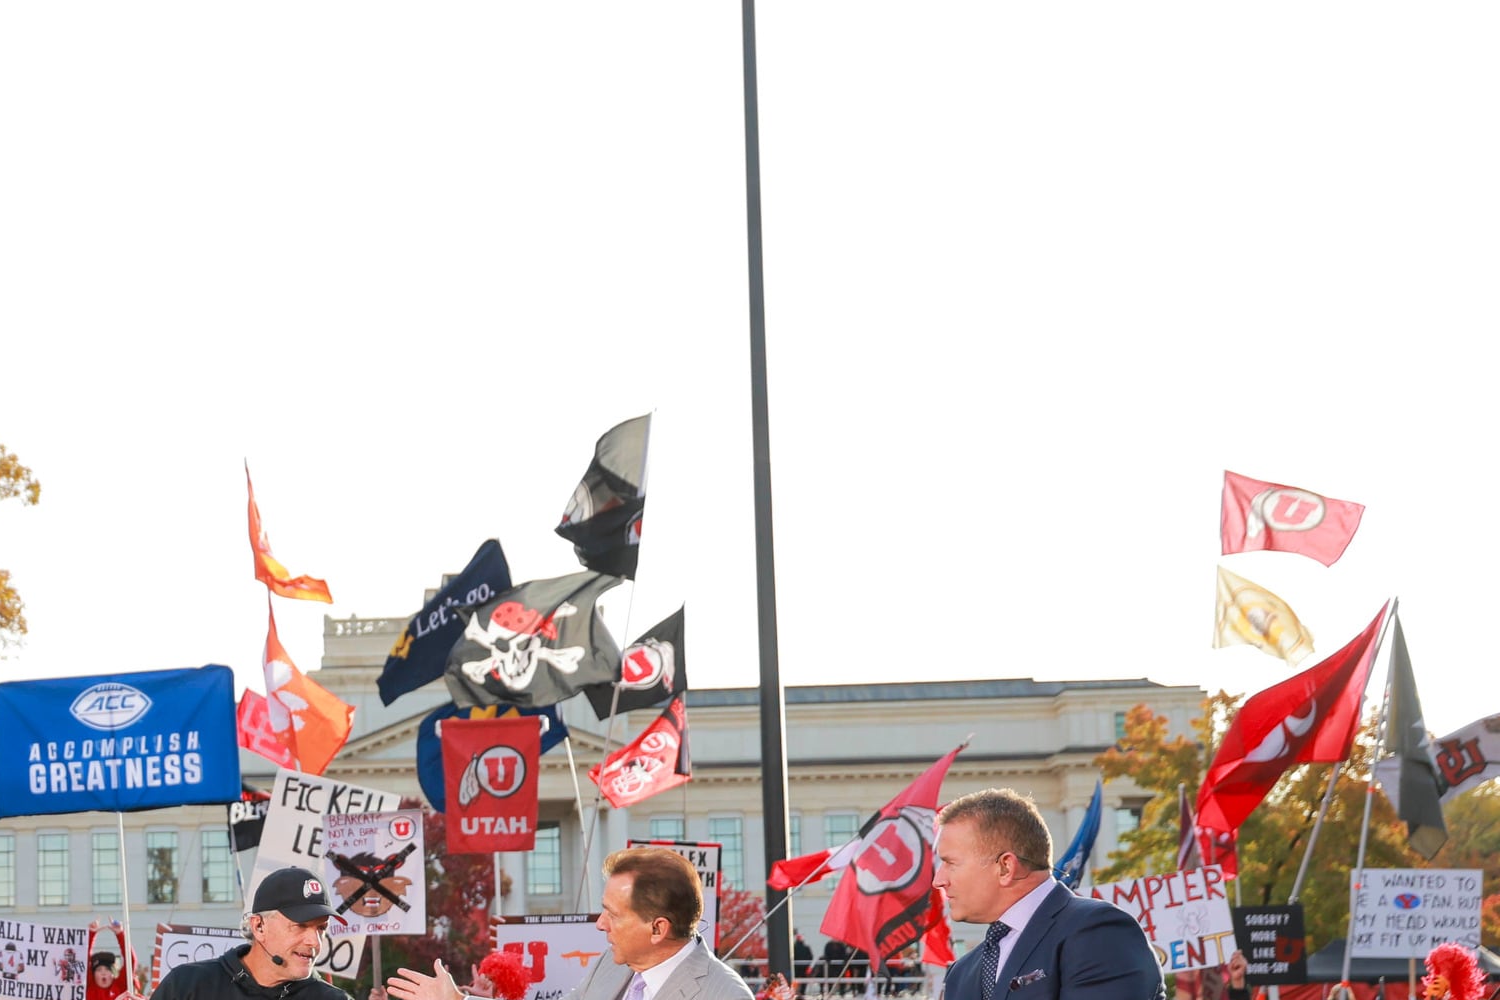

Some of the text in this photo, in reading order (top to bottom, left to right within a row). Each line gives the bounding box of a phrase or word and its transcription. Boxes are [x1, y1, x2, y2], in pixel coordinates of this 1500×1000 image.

[85, 692, 137, 712] ACC
[29, 730, 200, 762] ACCOMPLISH
[29, 753, 202, 794] GREATNESS
[460, 816, 528, 836] UTAH
[1091, 868, 1225, 910] AMPIER
[29, 925, 35, 943] I
[42, 926, 87, 946] WANT
[26, 949, 49, 967] MY
